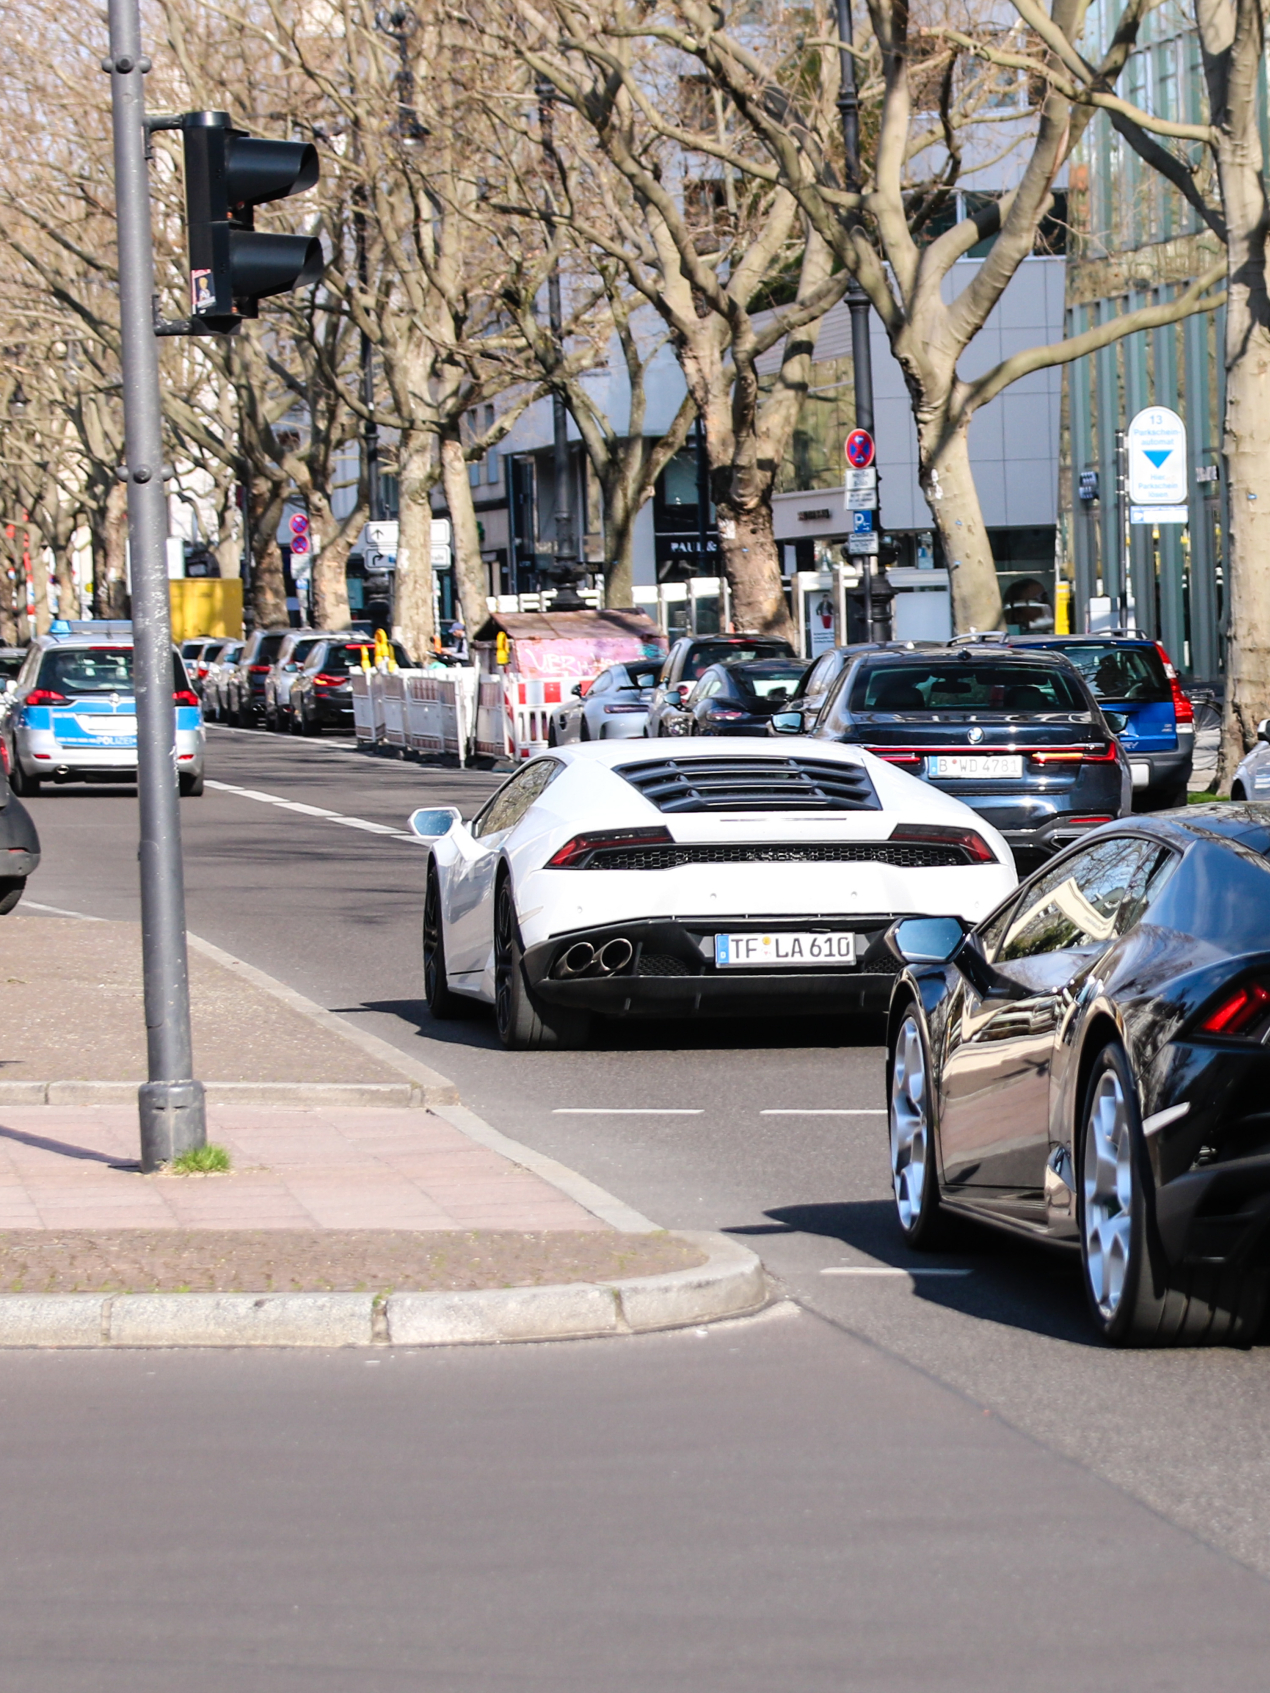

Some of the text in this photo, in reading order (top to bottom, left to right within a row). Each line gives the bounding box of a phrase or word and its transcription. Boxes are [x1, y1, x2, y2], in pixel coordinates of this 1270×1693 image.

[1150, 414, 1163, 425] 13
[939, 758, 1019, 773] B WD 4781
[731, 936, 850, 959] TF LA 610
